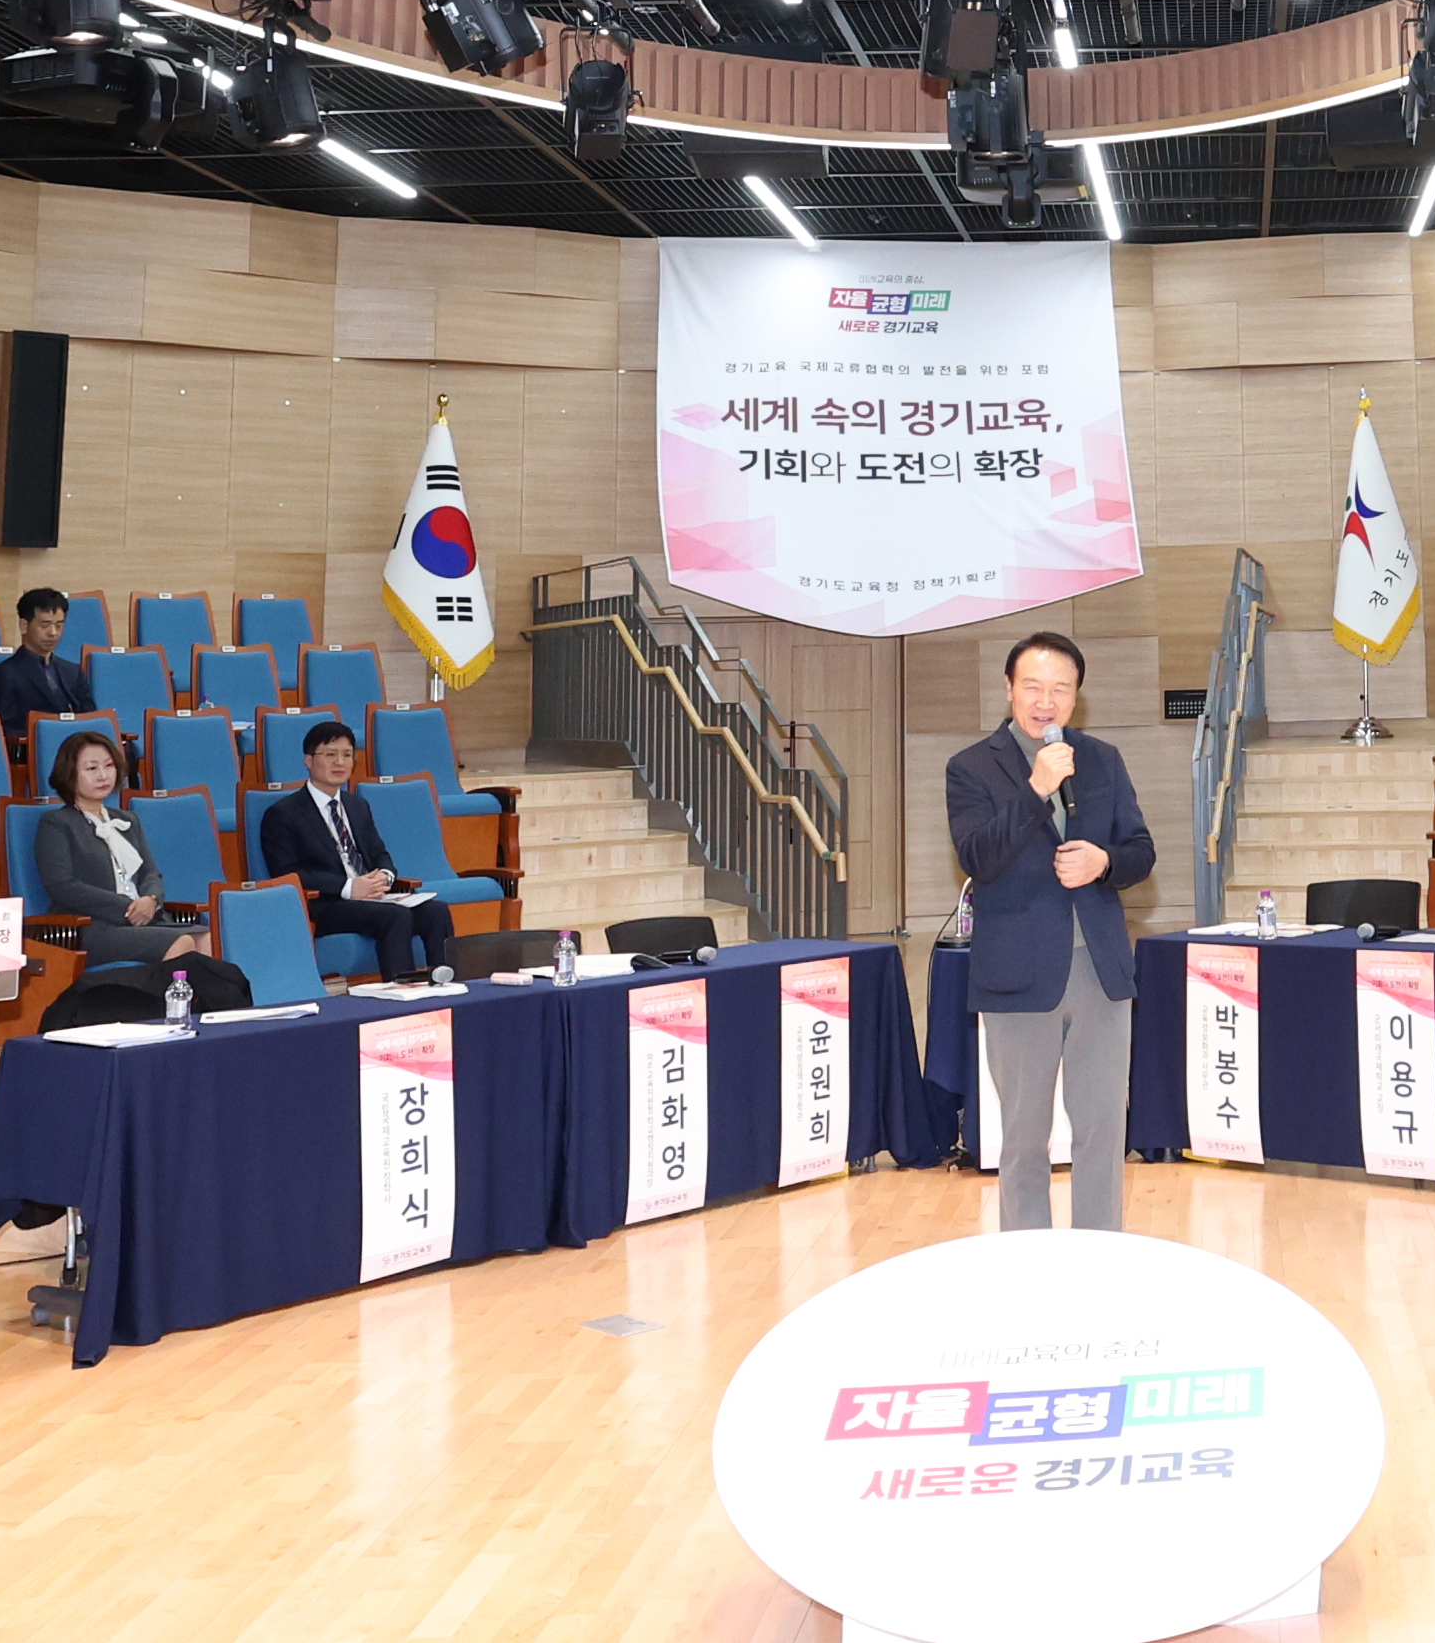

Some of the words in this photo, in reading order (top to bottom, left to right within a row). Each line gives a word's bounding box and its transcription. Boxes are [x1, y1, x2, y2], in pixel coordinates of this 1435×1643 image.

[832, 289, 868, 307] 자율
[872, 296, 907, 313] 균형
[911, 292, 947, 309] 미래
[838, 320, 880, 333] 새로운
[883, 321, 939, 334] 경기교육
[724, 361, 786, 374] 경기교육
[800, 361, 910, 376] 국제교류협력의
[923, 364, 968, 376] 발전을
[980, 364, 1009, 376] 위한
[1022, 364, 1049, 375] 포럼
[721, 397, 799, 433] 세계
[811, 398, 886, 435] 속의
[900, 398, 1063, 436] 경기교육,
[739, 448, 847, 483] 기회와
[856, 451, 962, 484] 도전의
[974, 448, 1043, 482] 확장
[798, 575, 899, 593] 경기도교육청
[913, 570, 996, 590] 정책기획관
[809, 1020, 832, 1144] 윤원희
[1215, 1004, 1240, 1129] 박봉수
[1389, 1014, 1419, 1145] 이용규
[661, 1045, 687, 1181] 김화영
[398, 1082, 430, 1230] 장희식
[1105, 1338, 1160, 1359] 중심
[844, 1388, 971, 1431] 자율
[988, 1392, 1111, 1439] 균형
[1131, 1372, 1251, 1418] 미래
[859, 1461, 1019, 1500] 새로운
[1034, 1446, 1235, 1491] 경기교육
